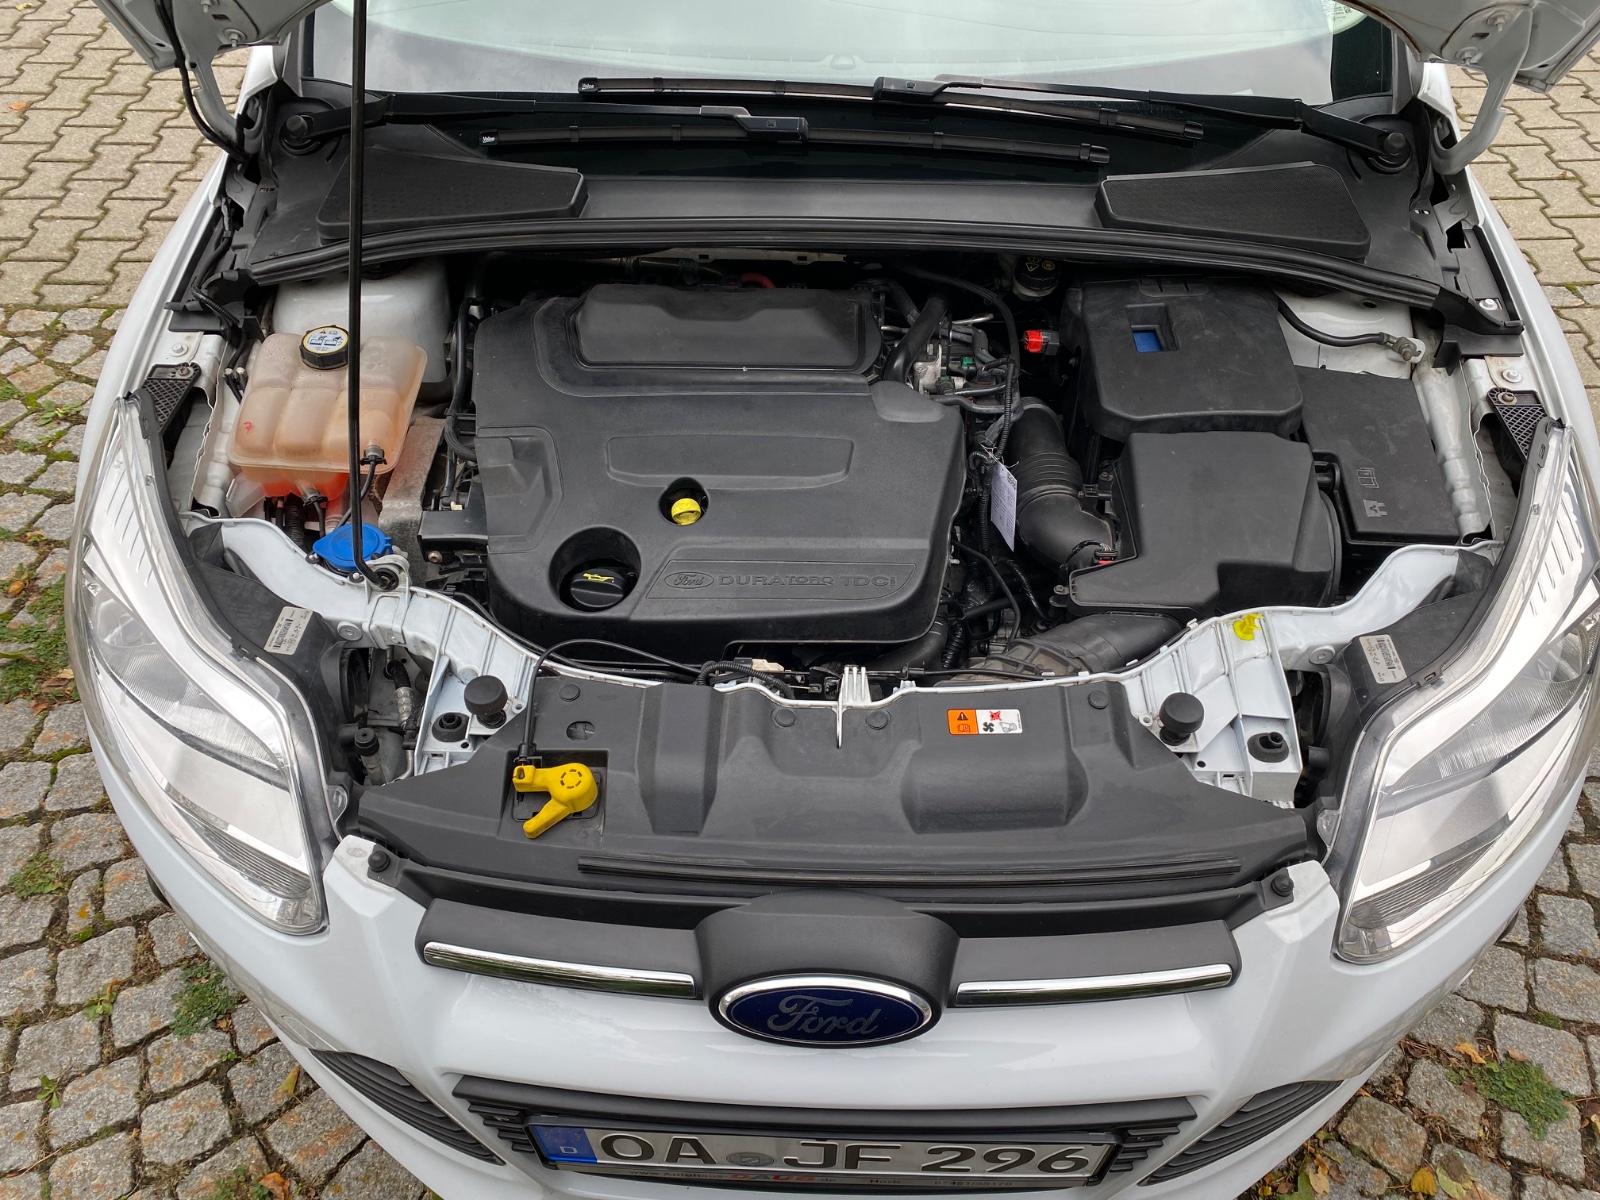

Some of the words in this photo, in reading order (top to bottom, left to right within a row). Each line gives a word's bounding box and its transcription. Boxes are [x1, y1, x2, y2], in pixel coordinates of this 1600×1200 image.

[674, 574, 705, 586] Ford
[766, 994, 883, 1036] Ford
[600, 1133, 718, 1165] OA
[783, 1140, 903, 1171] JF
[921, 1145, 1091, 1174] 296
